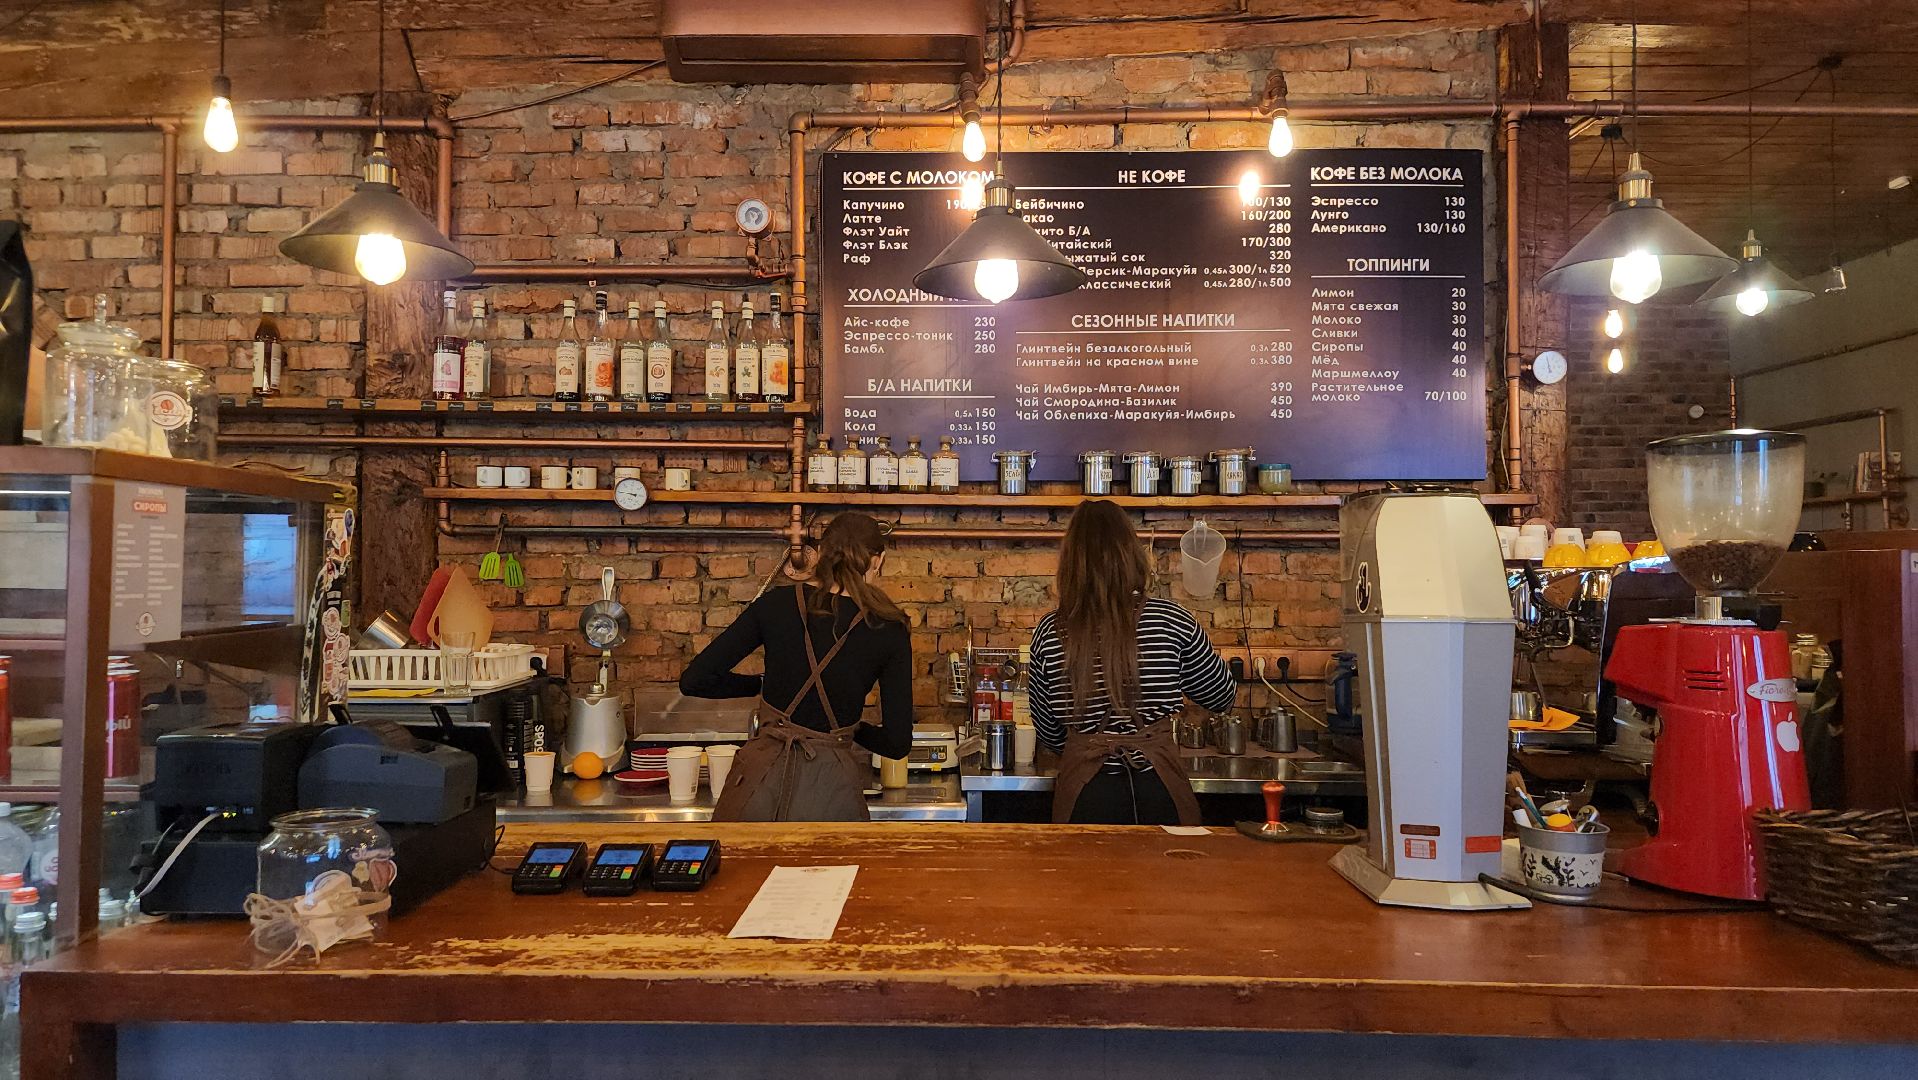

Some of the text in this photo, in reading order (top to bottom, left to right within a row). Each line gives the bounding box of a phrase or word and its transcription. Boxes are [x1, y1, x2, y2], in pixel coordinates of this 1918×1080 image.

[842, 170, 995, 185] КОФЕ С МОЛОКОМ
[1118, 169, 1186, 184] НЕ КОФЕ
[1310, 167, 1464, 181] КОФЕ БЕЗ МОЛОКА
[843, 199, 905, 212] Капучино
[1014, 198, 1085, 210] Бейбичино
[1311, 195, 1466, 208] Эспрессо 130
[842, 213, 882, 224] Латте
[1022, 209, 1291, 223] акао 160/200
[1310, 209, 1466, 221] Лунго 130
[842, 225, 910, 237] Флэт Уайт
[1034, 223, 1291, 237] хито Б/А 280
[1311, 222, 1466, 235] Американо 130/160
[842, 239, 909, 250] Флэт Блэк
[1047, 236, 1291, 250] итайский 170/300
[843, 253, 871, 266] Раф
[1121, 253, 1146, 262] сок
[1269, 250, 1291, 261] 320
[1078, 265, 1198, 278] Персик-Маракуйя
[1269, 264, 1291, 274] 520
[1346, 258, 1430, 272] ТОППИНГИ
[1269, 277, 1291, 288] 500
[1311, 287, 1466, 298] Лимон 20
[1311, 301, 1467, 311] Мята свежая 30
[843, 316, 996, 329] Айс-кофе 230
[1071, 313, 1235, 328] СЕЗОННЫЕ НАПИТКИ
[1311, 314, 1467, 325] Молоко 30
[843, 330, 996, 342] Эспрессо-тоник 250
[1311, 328, 1467, 338] Сливки 40
[843, 344, 996, 354] Бамбл 280
[1015, 343, 1081, 354] Глинтвейн
[1086, 341, 1192, 354] безалкогольный
[1270, 341, 1293, 352] 280
[1311, 341, 1467, 353] Сиропы 40
[1015, 356, 1081, 367] Глинтвейн
[1086, 358, 1101, 367] на
[1106, 358, 1164, 368] красном
[1168, 357, 1199, 366] вине
[1270, 355, 1293, 365] 380
[1311, 354, 1467, 366] Мёд 40
[1311, 368, 1467, 380] Маршмеллоу 40
[867, 378, 972, 394] Б/А НАПИТКИ
[1015, 382, 1293, 395] Чай Имбирь-Мята-Лимон 390
[1311, 382, 1404, 392] Растительное
[1015, 396, 1293, 408] Чай Смородина-Базилик 450
[1311, 391, 1467, 402] молоко 70/100
[844, 407, 996, 419] Вода 0,5л 150
[1015, 409, 1293, 421] Чай Облепиха-Маракуйя-Имбирь 450
[844, 421, 996, 432] Кола 0,33л 150
[844, 434, 881, 445] Тник
[975, 434, 996, 445] 150
